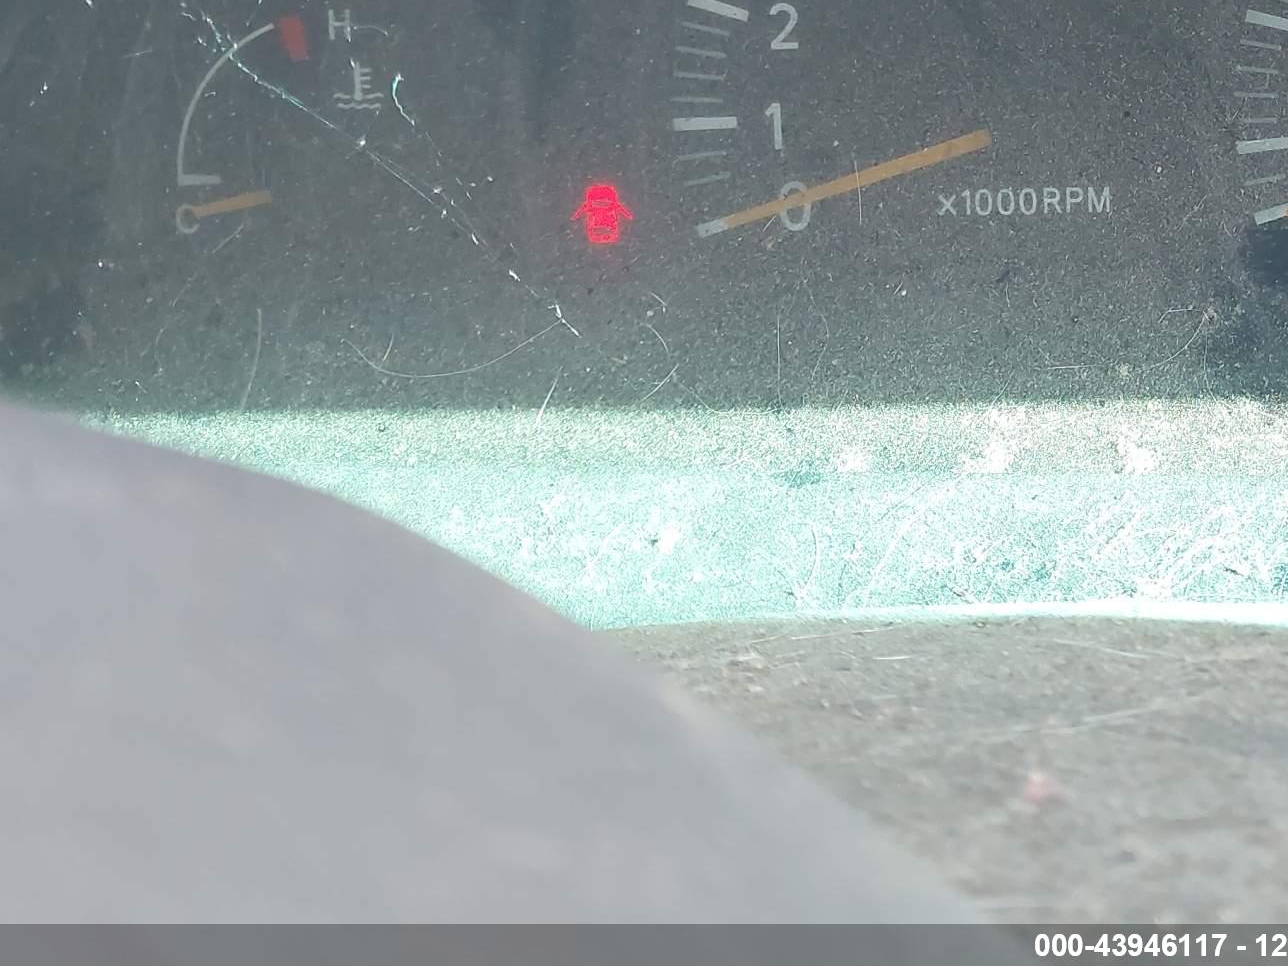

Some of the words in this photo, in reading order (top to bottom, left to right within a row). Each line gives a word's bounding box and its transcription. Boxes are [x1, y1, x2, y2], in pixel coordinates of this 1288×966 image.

[328, 9, 352, 40] H
[769, 3, 800, 50] 2
[763, 102, 784, 150] 1
[779, 180, 812, 233] 0
